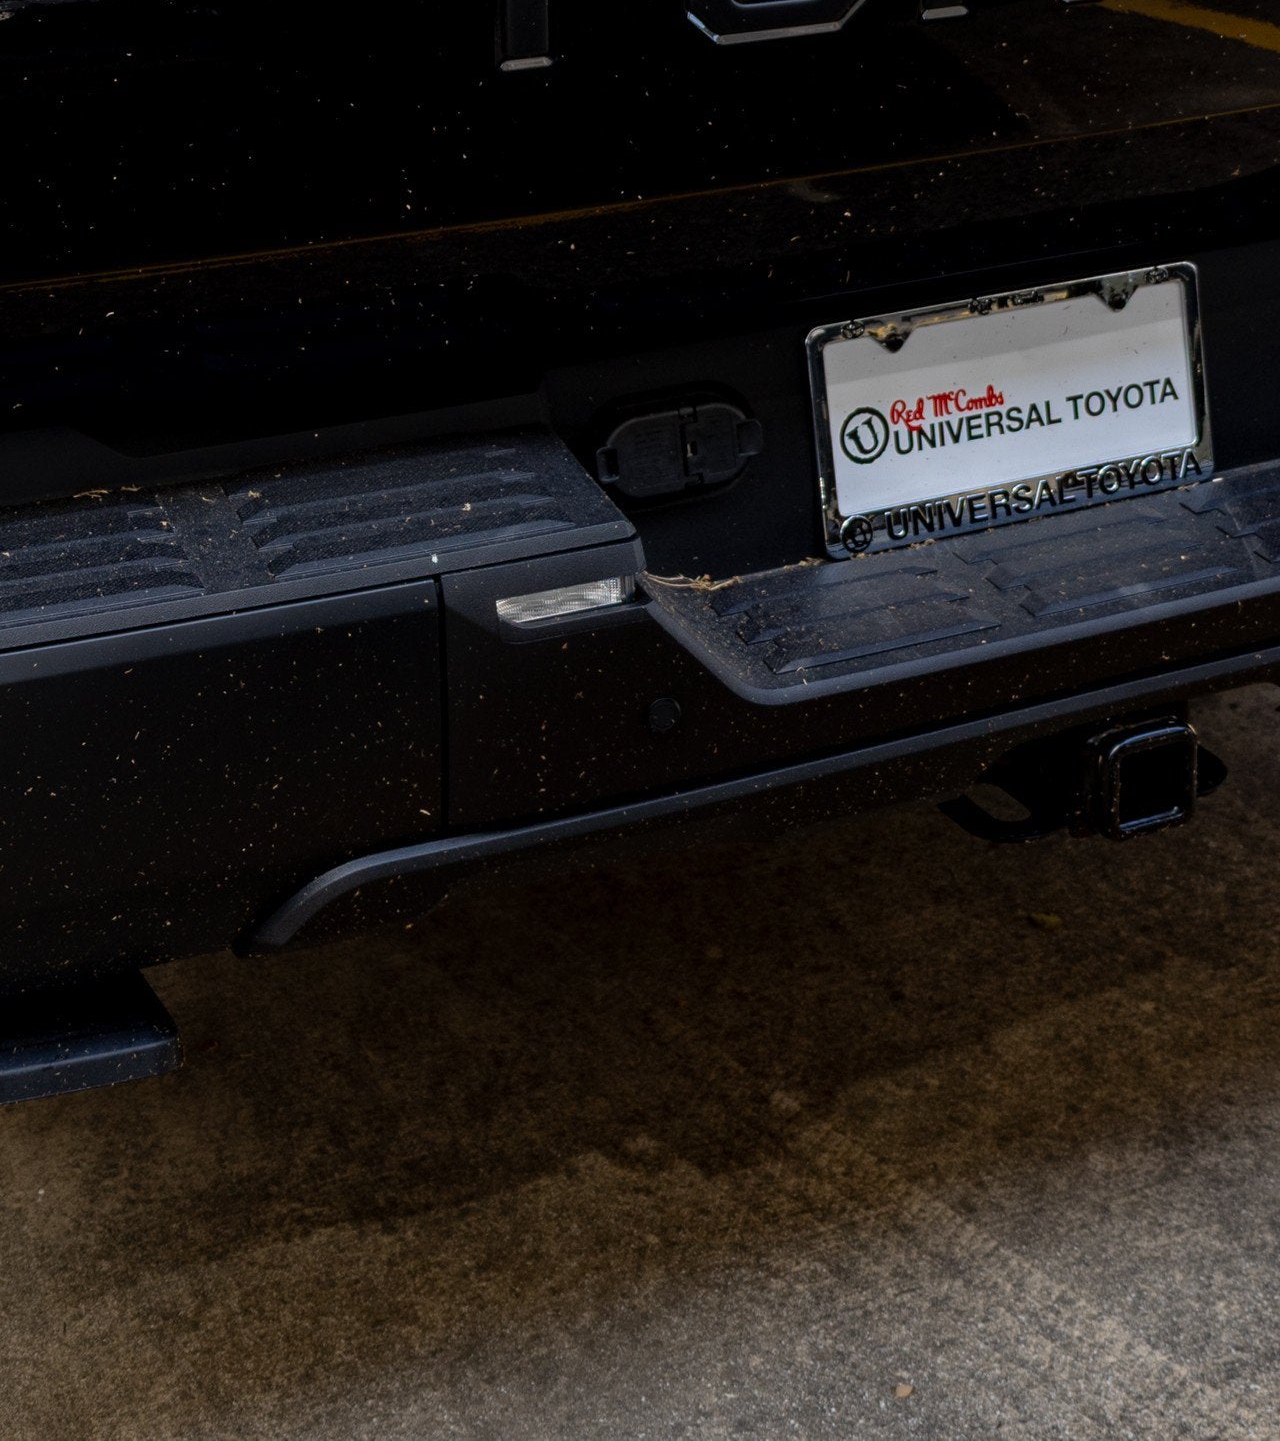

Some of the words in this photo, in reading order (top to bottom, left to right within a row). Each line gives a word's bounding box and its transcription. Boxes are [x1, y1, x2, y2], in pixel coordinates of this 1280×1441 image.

[890, 397, 925, 432] Red
[926, 384, 1004, 417] McCombs
[893, 400, 1062, 455] UNIVERSAL
[1065, 377, 1179, 420] TOYOTA
[884, 477, 1076, 540] UNIVERSAL
[1076, 448, 1203, 498] TOYOTA
